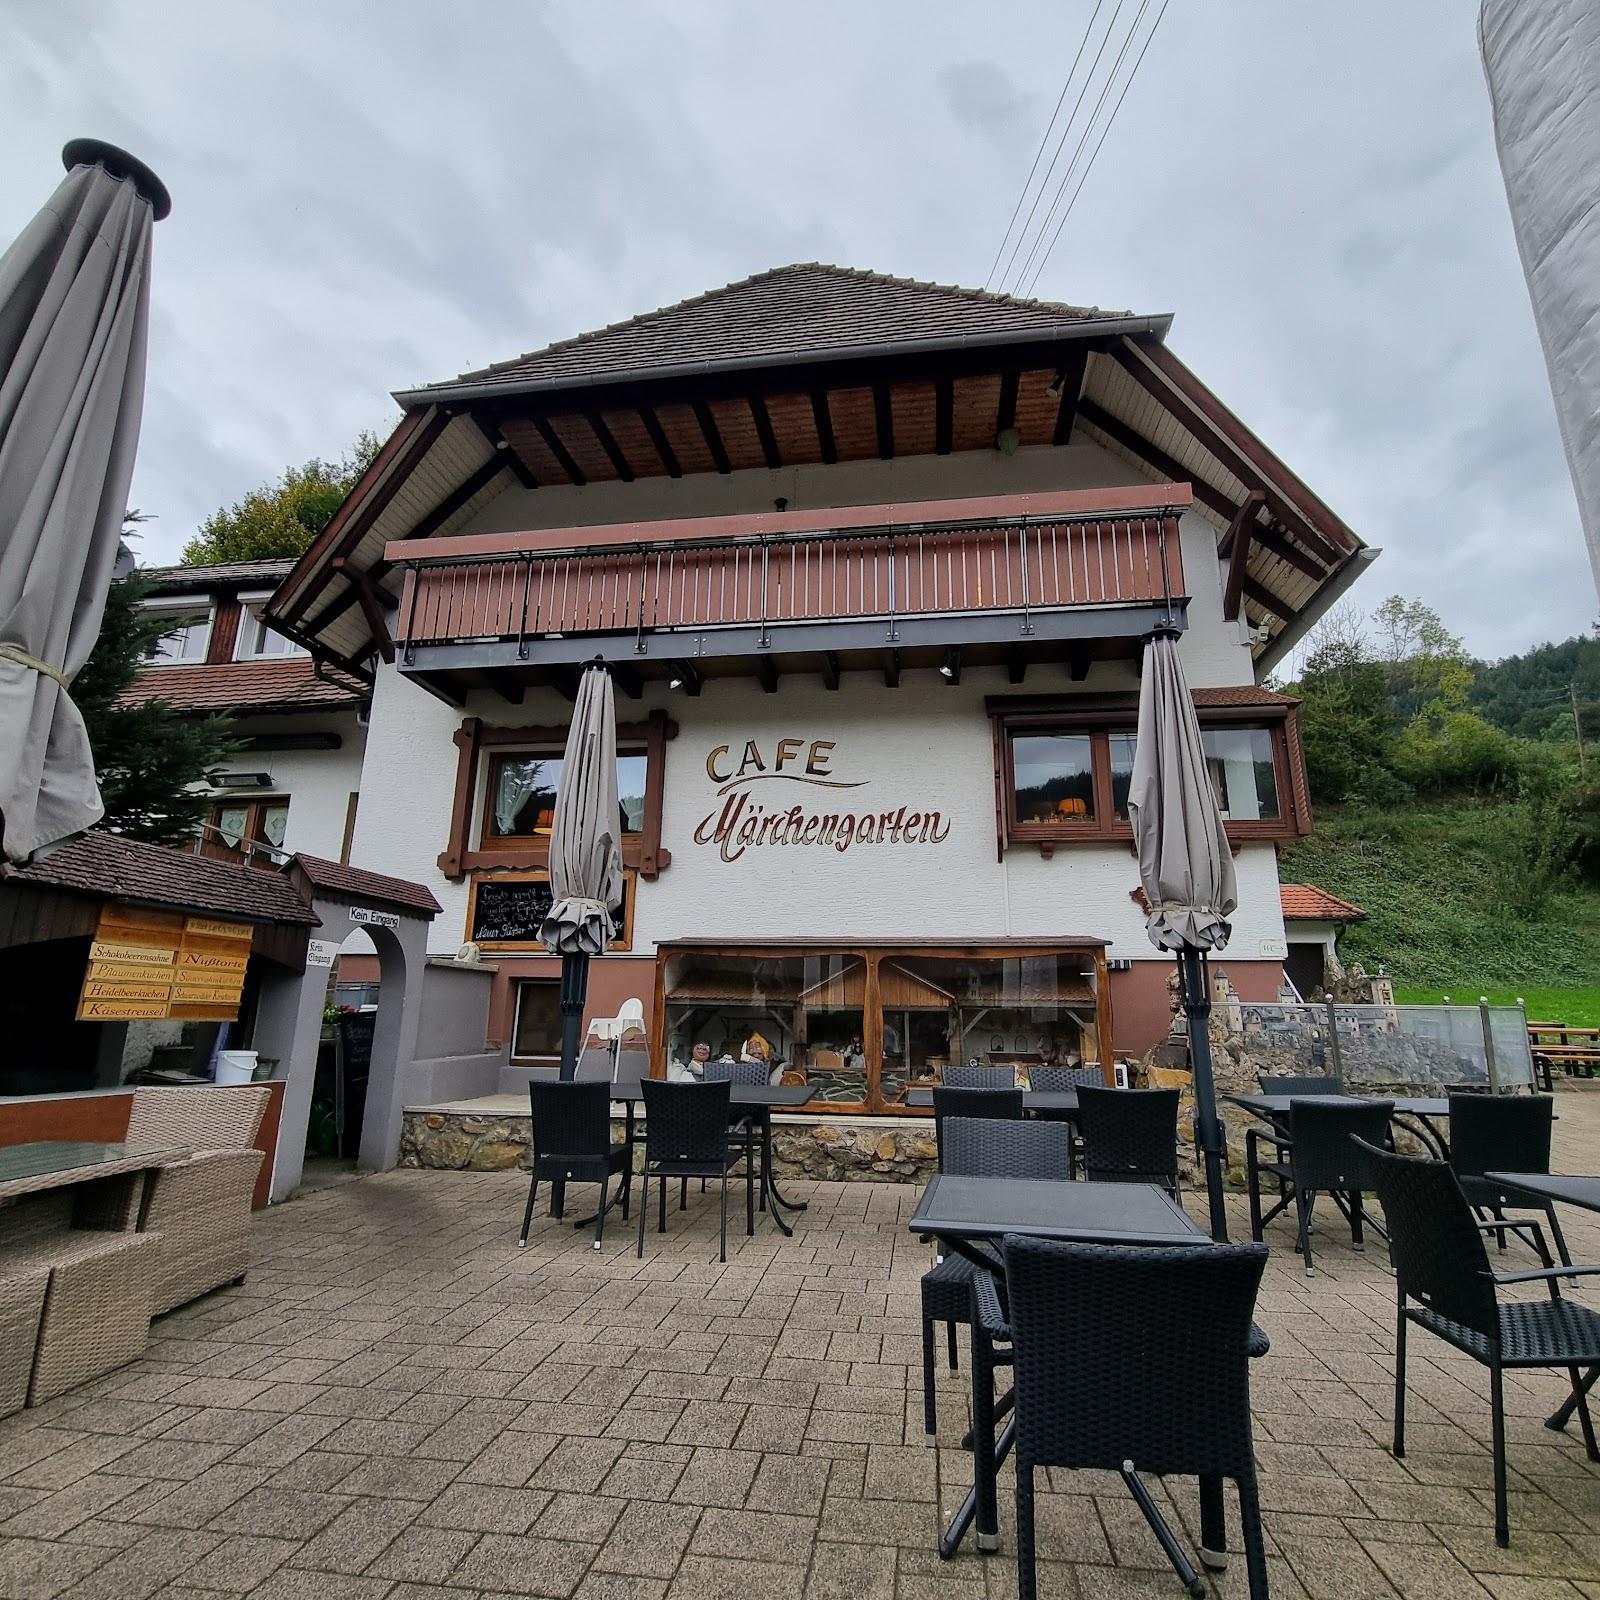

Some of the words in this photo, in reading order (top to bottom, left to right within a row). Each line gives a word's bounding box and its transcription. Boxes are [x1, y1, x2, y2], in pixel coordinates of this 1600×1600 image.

[706, 738, 837, 784] CAFE
[693, 790, 951, 863] Märchengarten
[351, 907, 368, 921] Kein
[371, 911, 399, 927] Eingang
[475, 924, 500, 939] Neuer
[94, 945, 170, 963] Schokobeerensahne
[310, 941, 323, 952] Kein
[184, 954, 244, 969] Nußtorte
[308, 952, 331, 964] Eingang
[96, 964, 171, 980] Pflaumenkuchen
[90, 984, 165, 998] Heidelbeerkuchen
[89, 1001, 164, 1017] Käsestreusel
